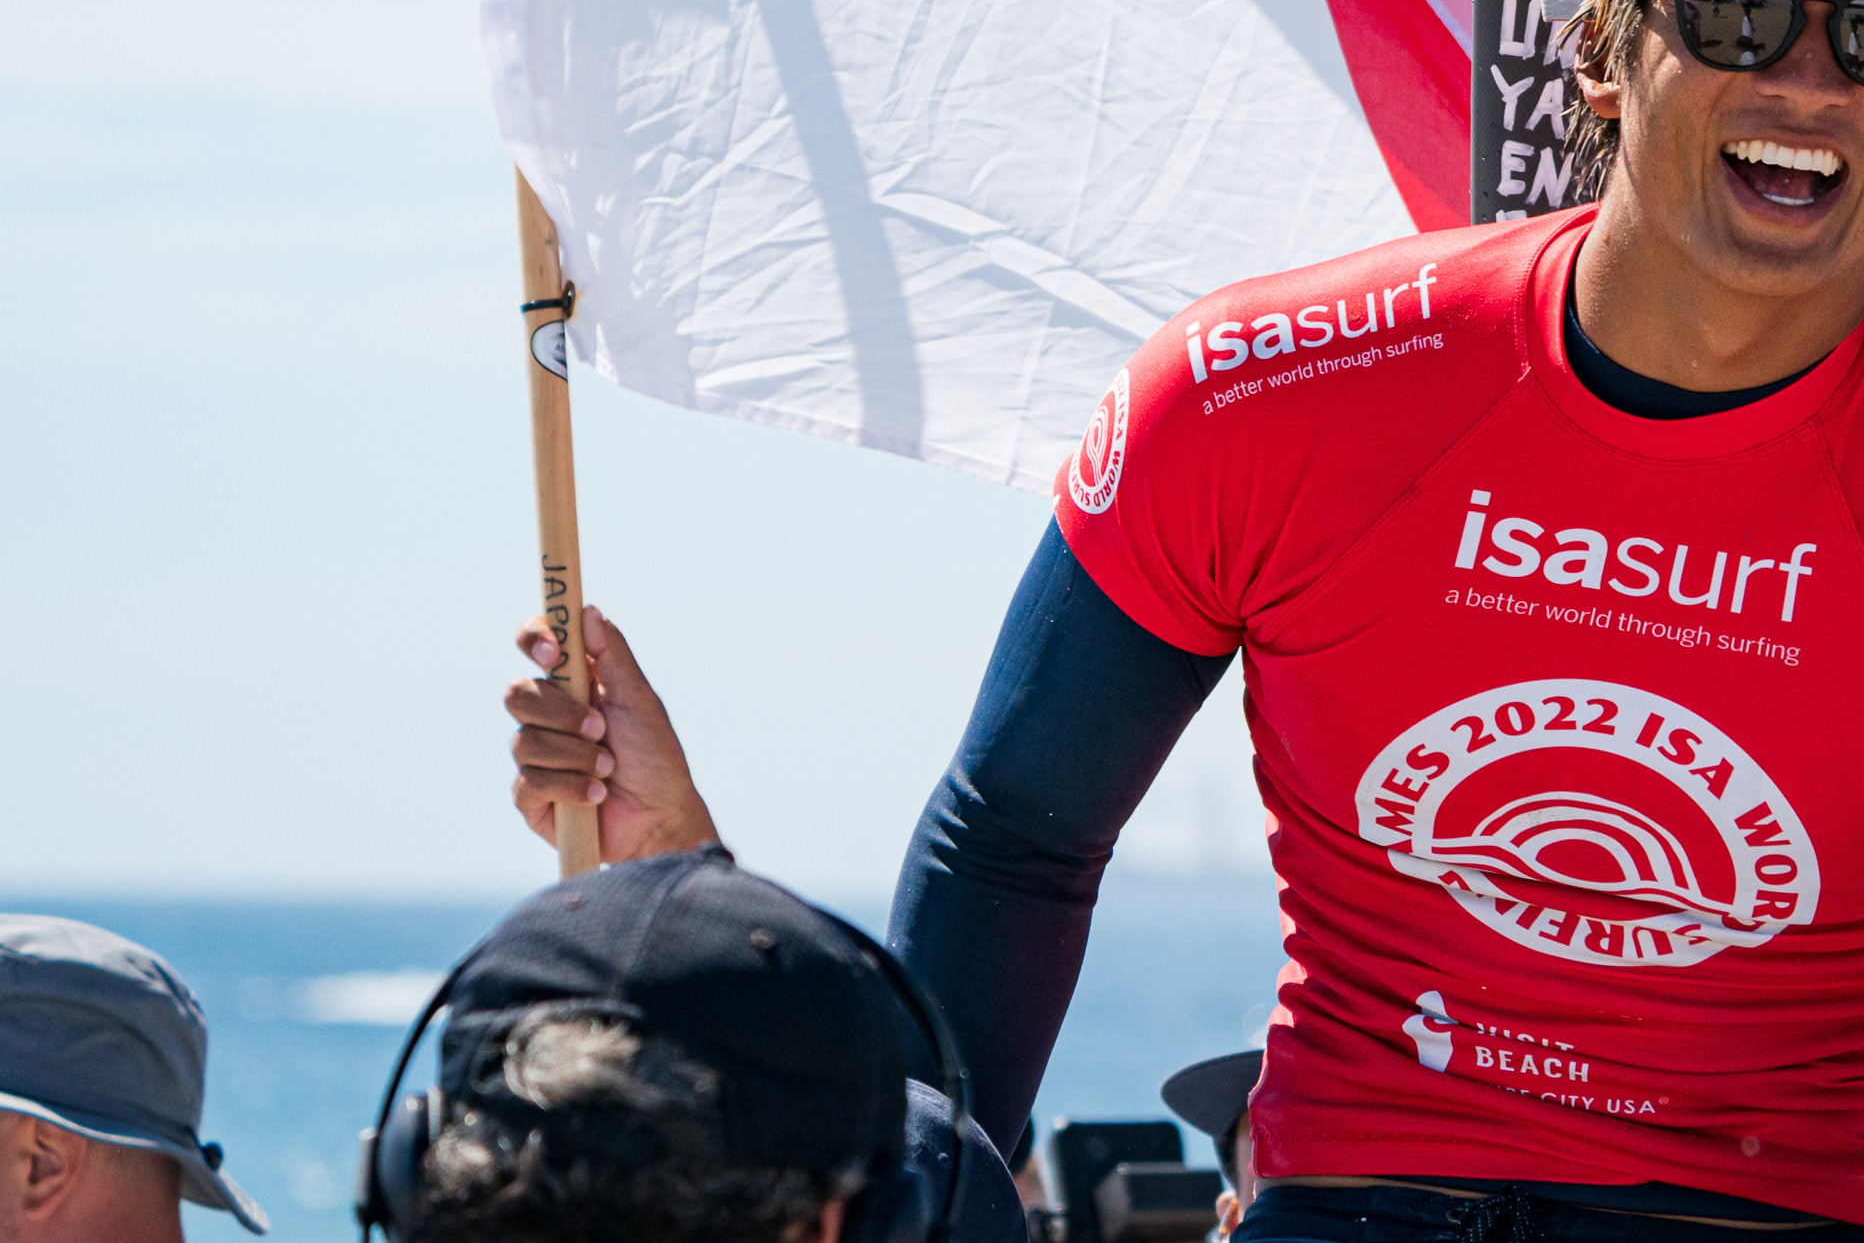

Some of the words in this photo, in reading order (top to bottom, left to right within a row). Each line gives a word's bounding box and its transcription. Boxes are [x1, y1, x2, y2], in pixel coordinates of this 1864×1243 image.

[1184, 262, 1437, 385] isasurf
[1202, 399, 1214, 416] a
[1214, 375, 1264, 410] better
[1267, 361, 1315, 389] world
[1316, 345, 1384, 375] through
[1385, 332, 1445, 358] surfing
[1093, 450, 1121, 508] WORLD
[1453, 489, 1817, 623] isasurf
[1445, 589, 1460, 606] a
[1465, 587, 1540, 618] better
[1545, 603, 1612, 630] world
[1617, 612, 1711, 649] through
[1717, 632, 1801, 667] surfing
[1375, 743, 1451, 855] MES
[1449, 694, 1620, 754] 2022
[1635, 711, 1737, 801] ISA
[1722, 800, 1801, 932] WOR
[1475, 1045, 1590, 1083] BEACH
[1606, 1099, 1657, 1115] USA
